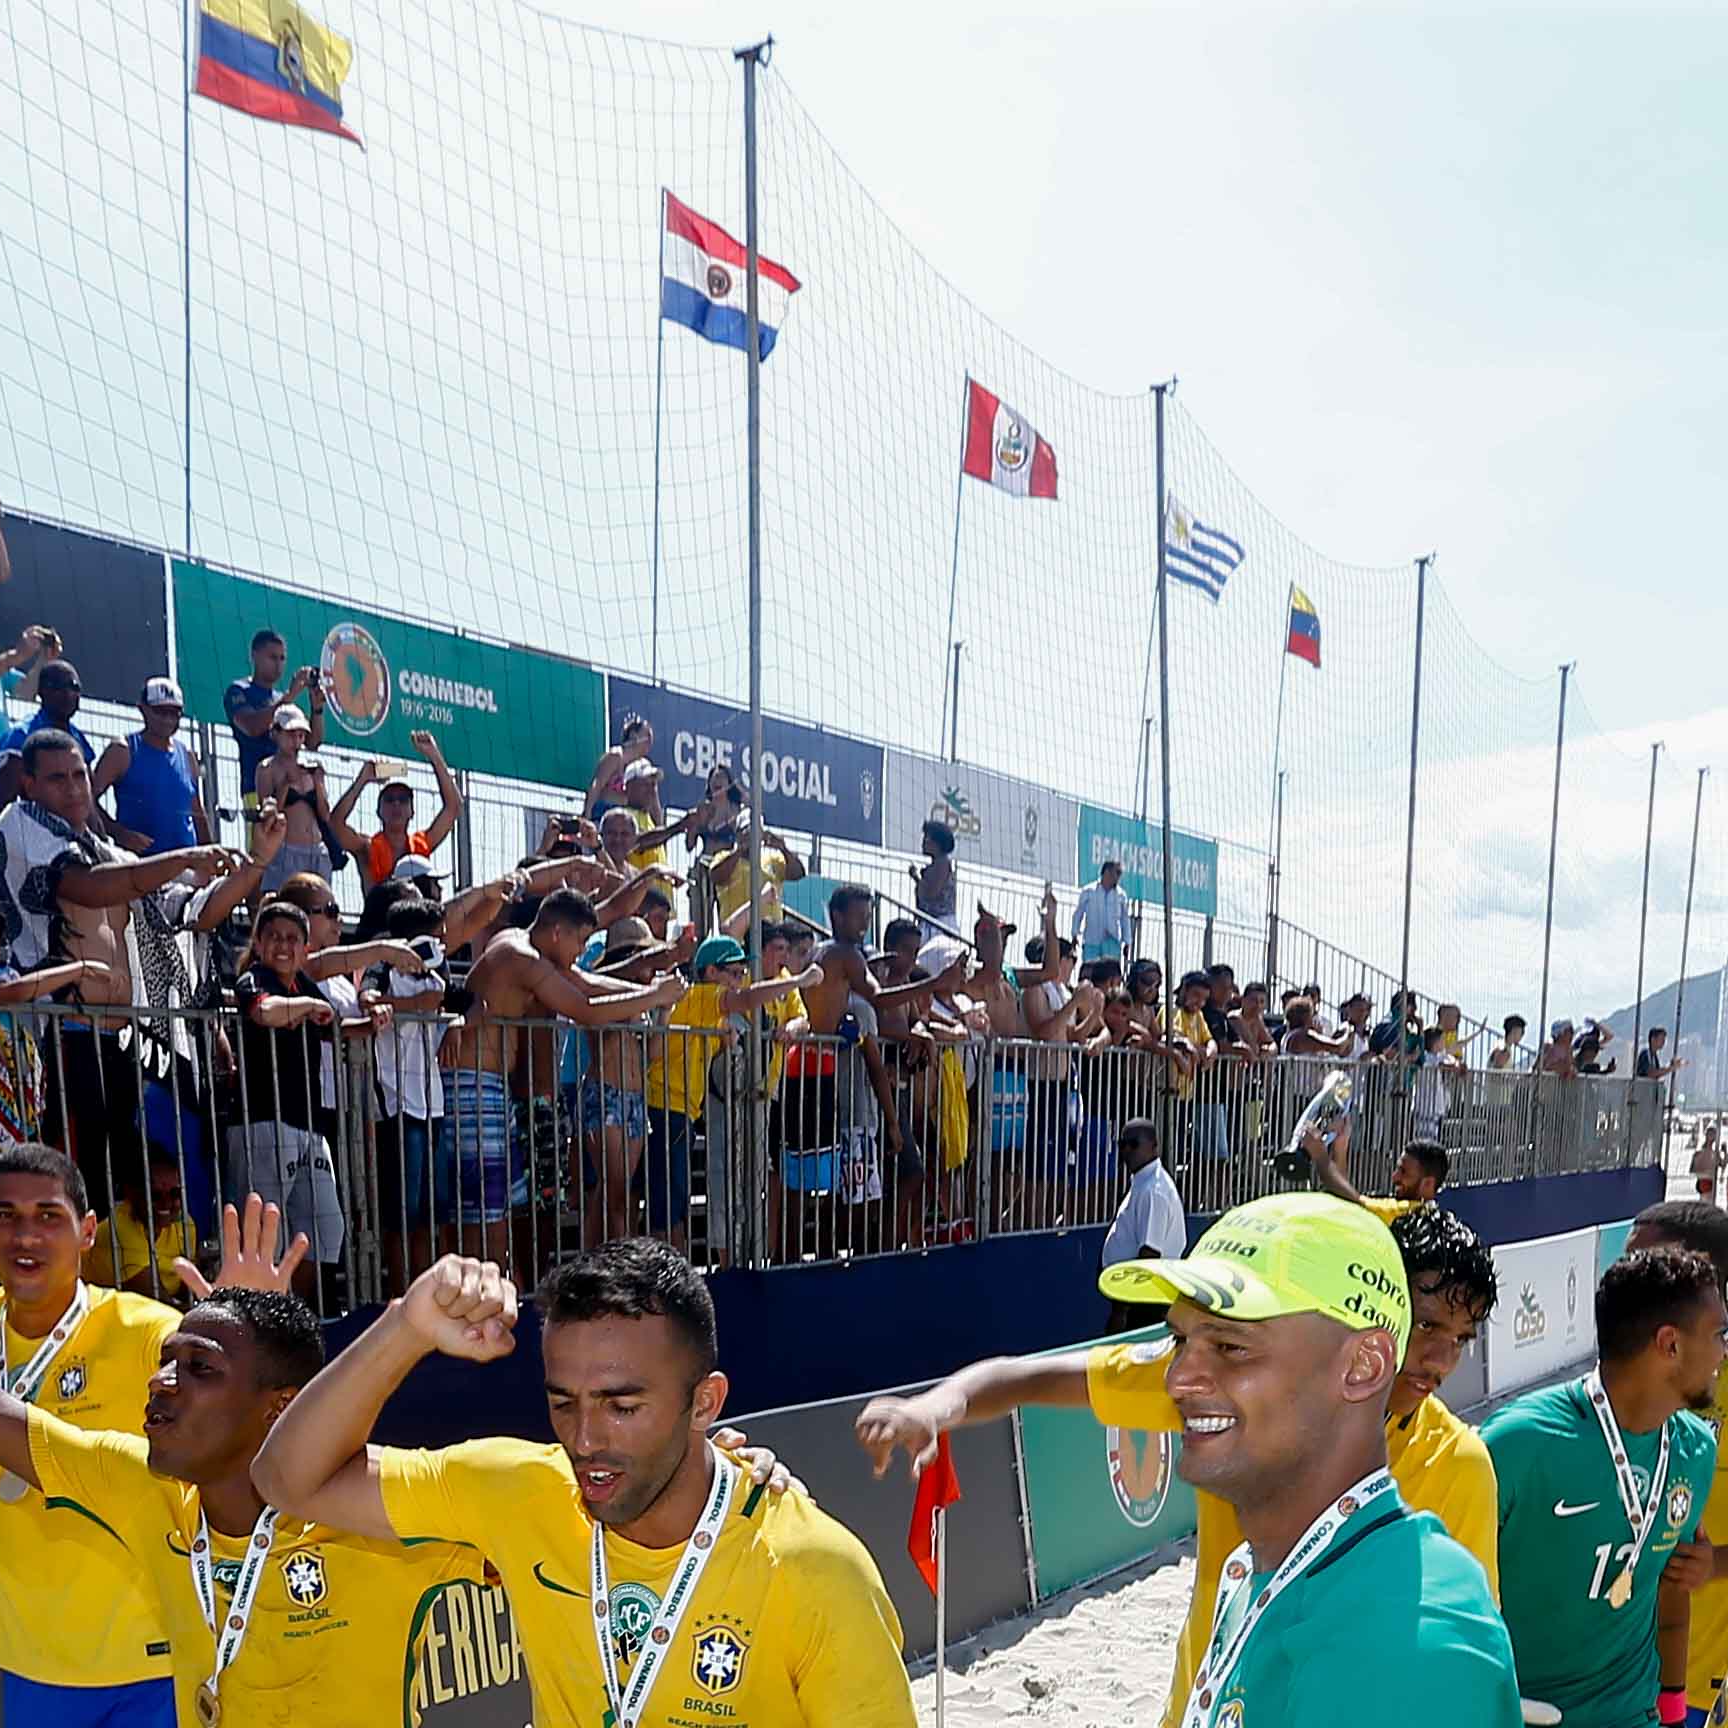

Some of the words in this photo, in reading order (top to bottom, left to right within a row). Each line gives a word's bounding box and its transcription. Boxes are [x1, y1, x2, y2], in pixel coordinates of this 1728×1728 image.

[398, 669, 498, 713] CONMEBOL
[1347, 1262, 1406, 1309] cobra
[1277, 1520, 1334, 1582] CONMEBOL
[663, 1556, 698, 1619] CONMEBOL
[288, 1608, 331, 1623] BRASIL
[627, 1651, 657, 1711] CONMEBOL
[683, 1697, 736, 1716] BRASIL
